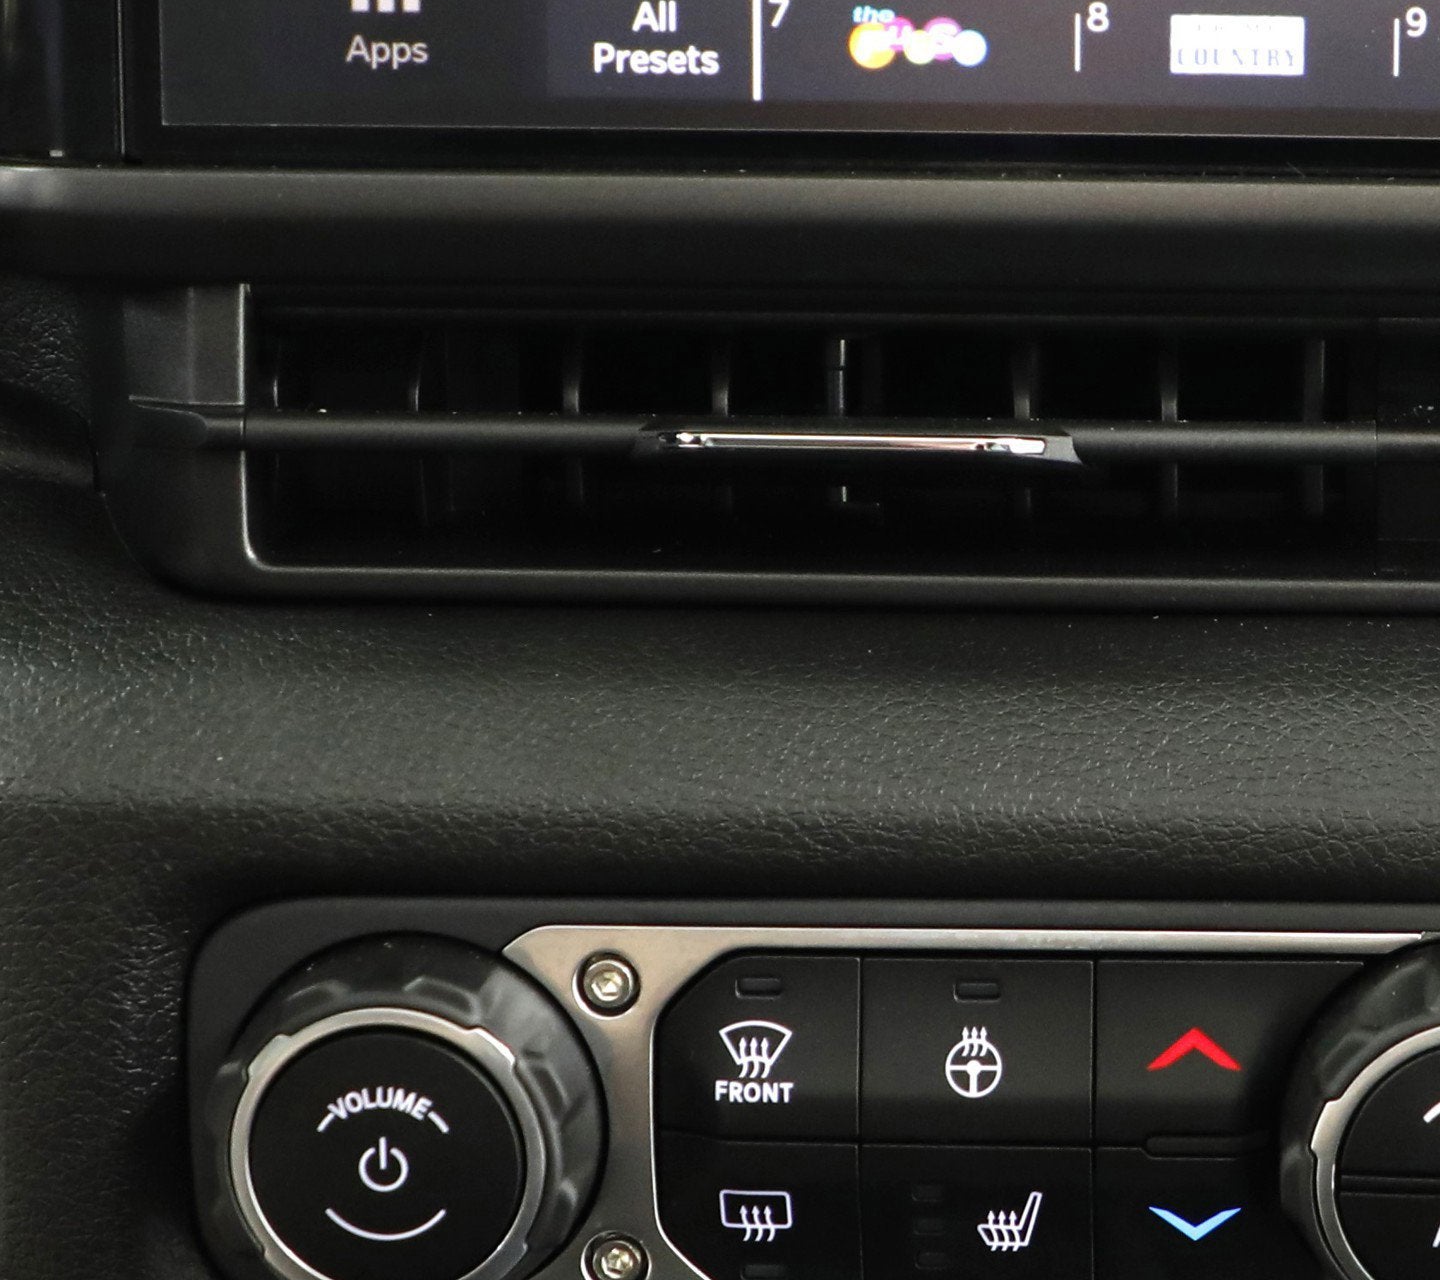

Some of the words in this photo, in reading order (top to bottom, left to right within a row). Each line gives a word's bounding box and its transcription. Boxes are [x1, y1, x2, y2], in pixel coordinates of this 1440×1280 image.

[631, 0, 677, 33] All
[852, 5, 895, 23] the
[1086, 1, 1111, 33] 8
[1405, 7, 1427, 38] 9
[345, 35, 429, 67] Apps
[592, 41, 720, 77] Presets
[328, 1086, 432, 1121] VOLUME
[714, 1081, 794, 1103] FRONT
